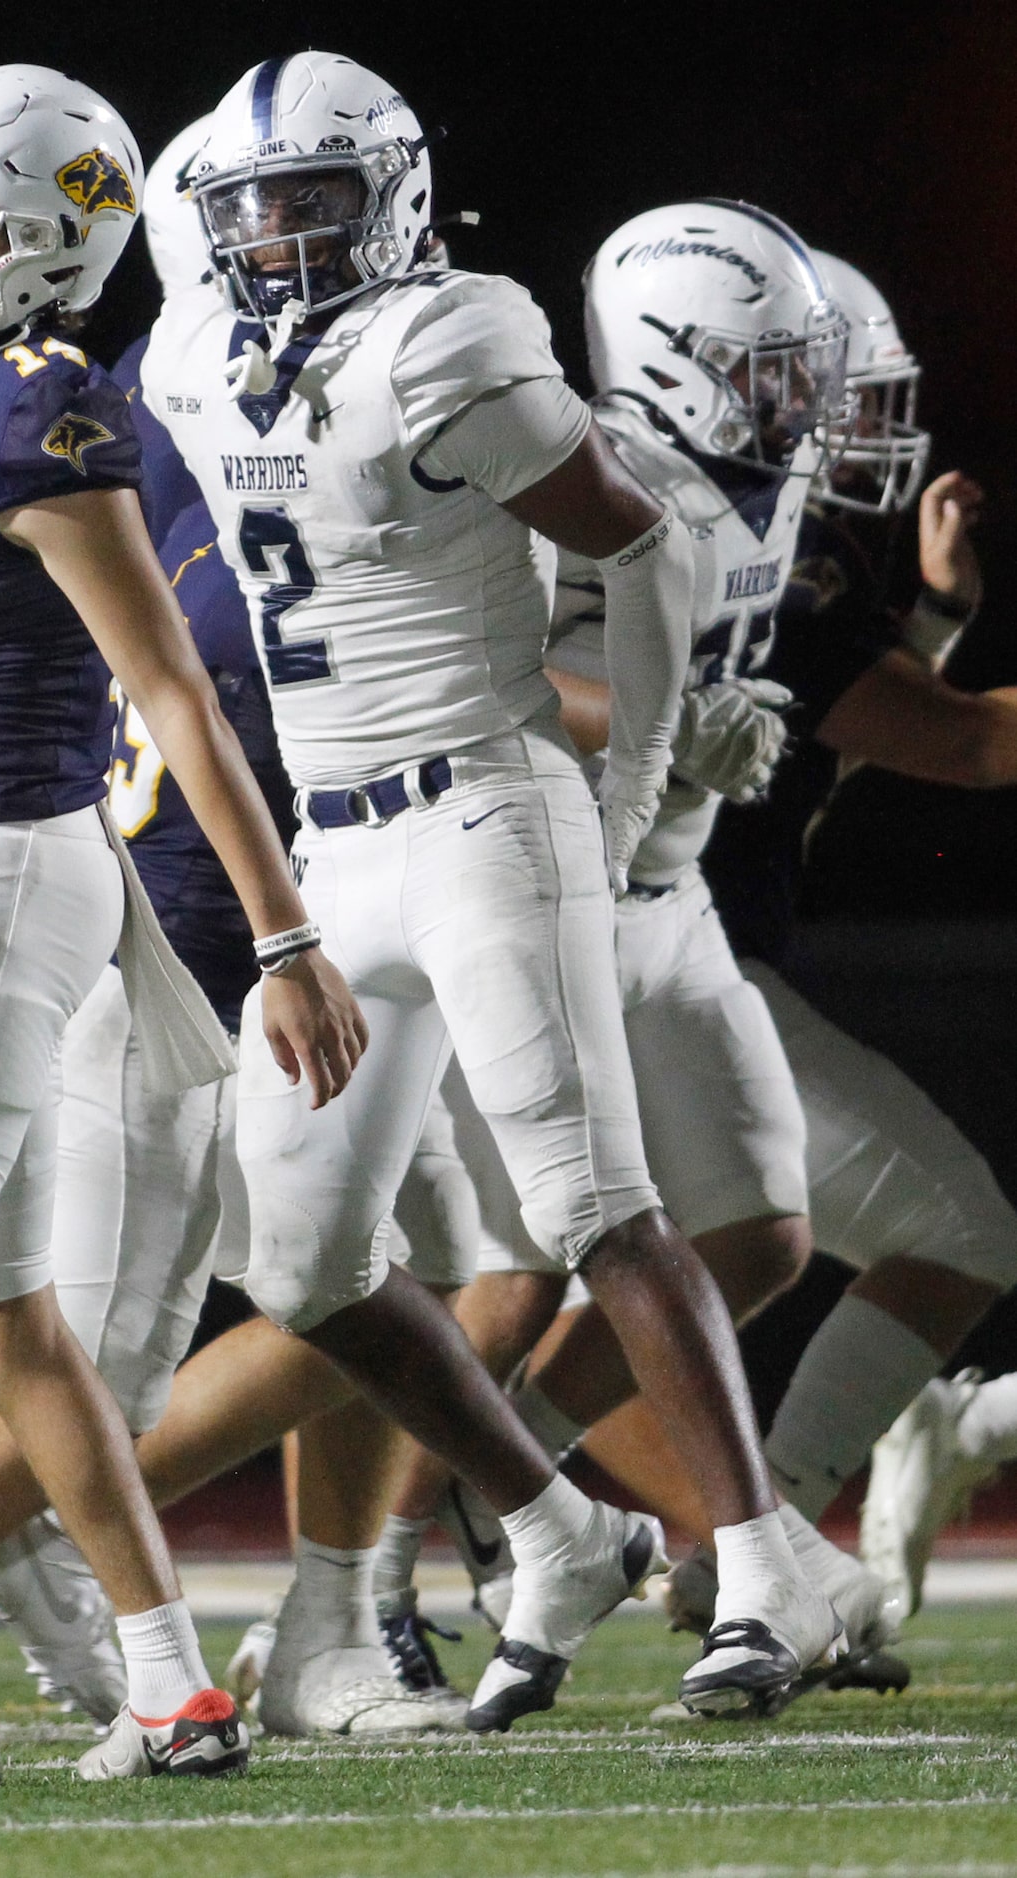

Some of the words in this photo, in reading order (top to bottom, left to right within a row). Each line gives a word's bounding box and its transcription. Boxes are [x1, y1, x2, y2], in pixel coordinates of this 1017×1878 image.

[166, 396, 183, 413] FOR
[221, 453, 308, 491] WARRIORS
[236, 499, 341, 693] 2
